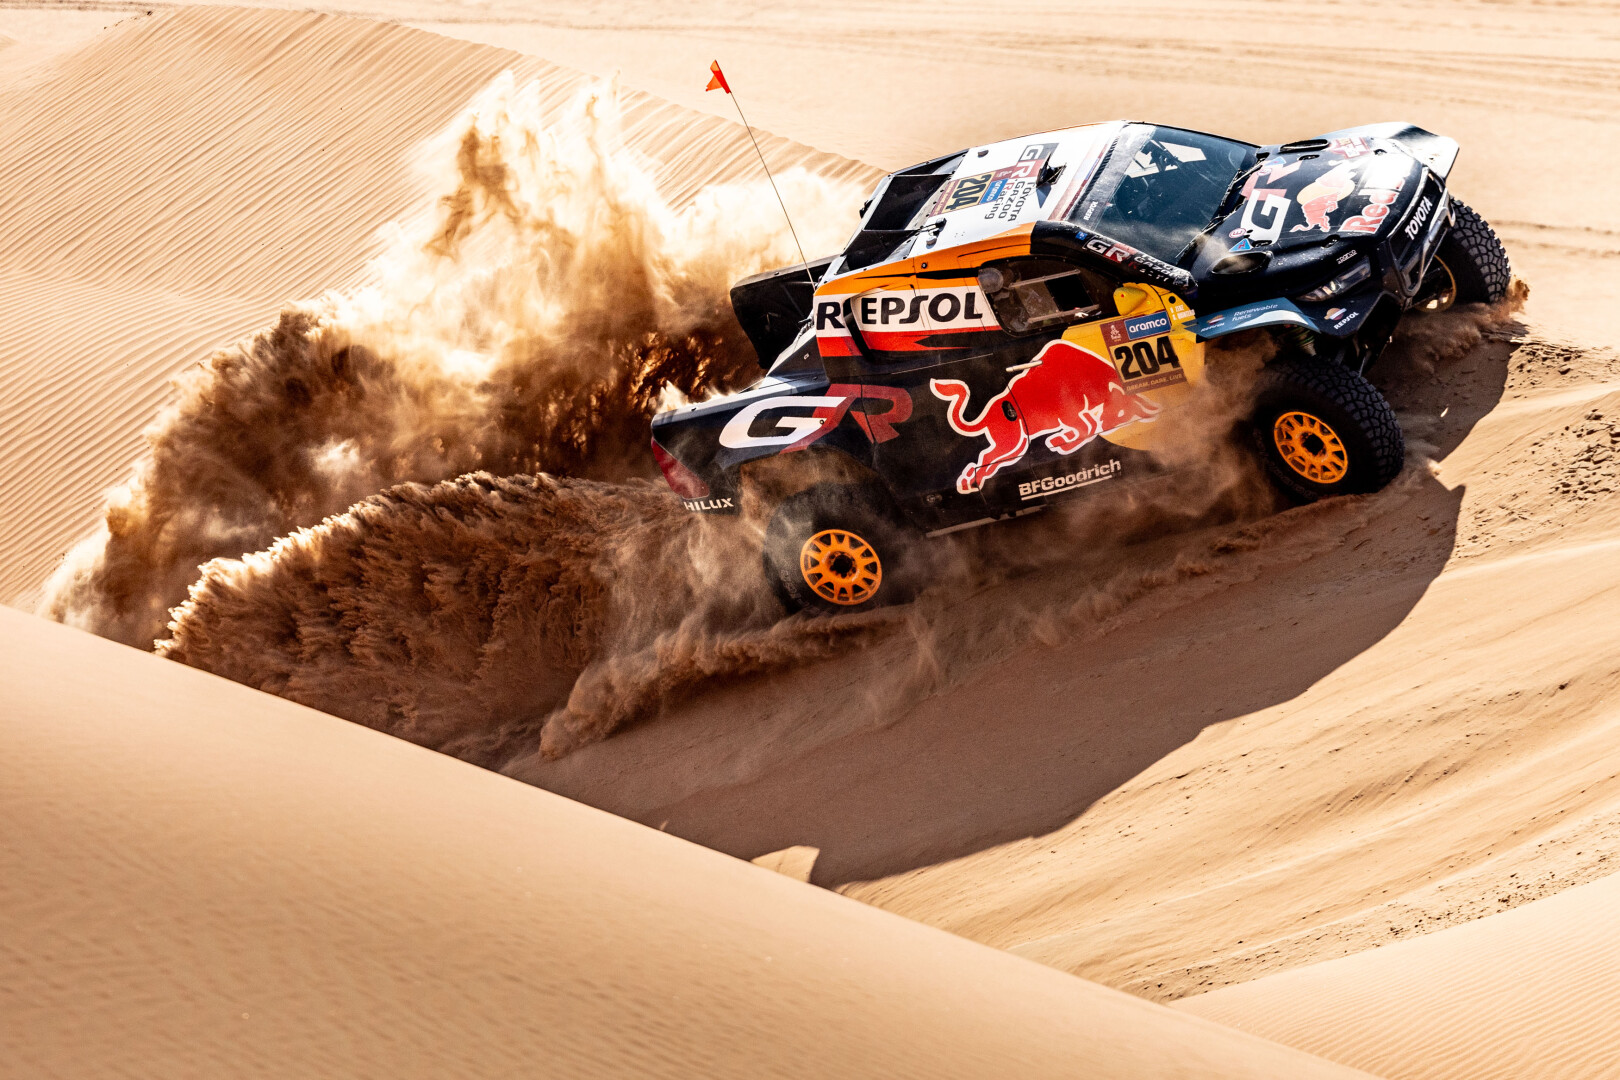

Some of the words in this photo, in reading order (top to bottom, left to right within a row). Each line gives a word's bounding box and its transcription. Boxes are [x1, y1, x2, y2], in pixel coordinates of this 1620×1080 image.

[1010, 144, 1044, 178] GR
[944, 173, 992, 211] 204
[984, 182, 1014, 220] Racing
[998, 181, 1025, 219] GAZOO
[1007, 181, 1036, 222] TOYOTA
[1083, 200, 1099, 221] REPSOL
[1337, 187, 1401, 235] Red
[1404, 195, 1434, 241] TOYOTA
[1086, 238, 1131, 263] GR
[816, 292, 984, 330] REPSOL
[1128, 317, 1168, 333] aramco
[1231, 313, 1252, 322] fuels
[1233, 303, 1279, 318] Renewable
[1333, 311, 1360, 330] REPSOL
[1113, 335, 1181, 381] 204
[718, 383, 914, 450] GR
[1018, 459, 1121, 497] BFGoodrich
[683, 497, 735, 511] HILUX
